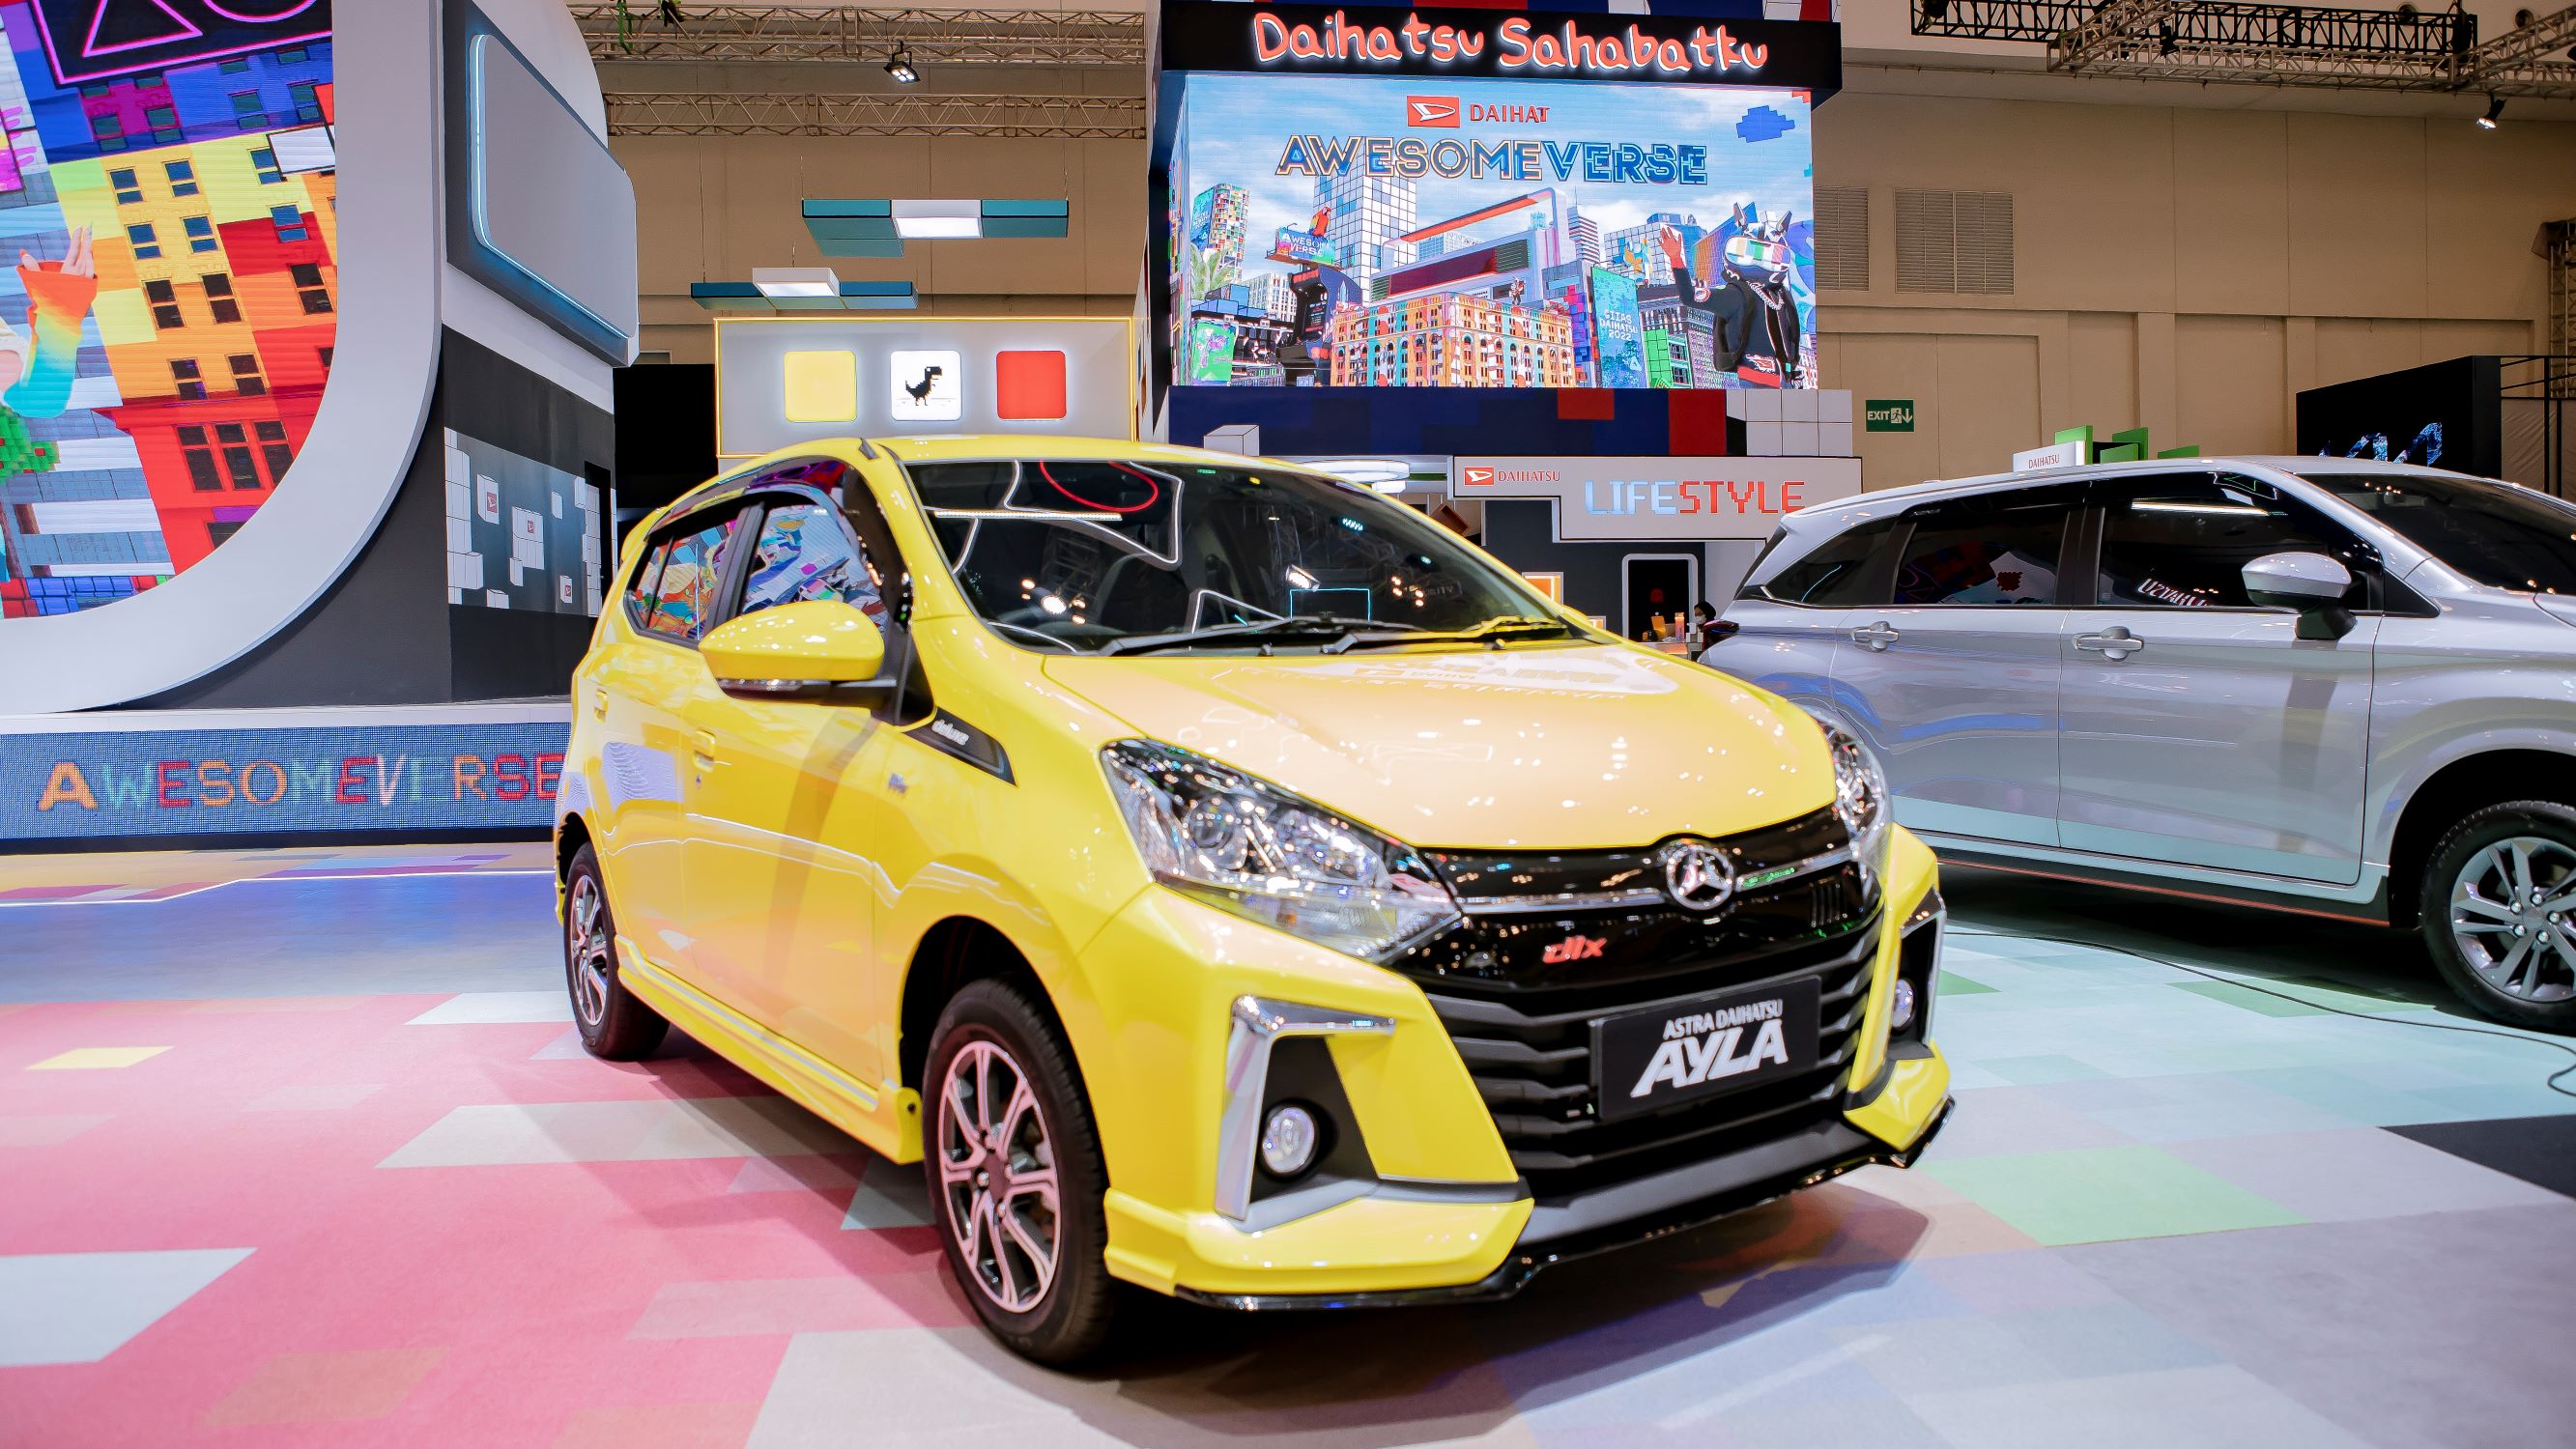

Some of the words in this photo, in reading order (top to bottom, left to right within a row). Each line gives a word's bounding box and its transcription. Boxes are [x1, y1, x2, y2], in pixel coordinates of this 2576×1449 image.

[1253, 10, 1484, 62] Daihatsu
[1499, 17, 1768, 71] Sahabatku
[1274, 134, 1708, 185] AWESOMEVERSE
[1599, 317, 1639, 334] DAIHATSU
[1604, 309, 1632, 325] GIIAS
[1609, 329, 1631, 341] 2022
[1867, 411, 1890, 421] EXIT
[2028, 455, 2060, 469] DAIHATSU
[1498, 470, 1560, 482] DAIHATSU
[1585, 480, 1806, 515] LIFESTYLE
[1663, 1012, 1715, 1040] ASTRA
[1715, 998, 1784, 1029] DAIHATSU
[1630, 1018, 1789, 1098] AYLA
